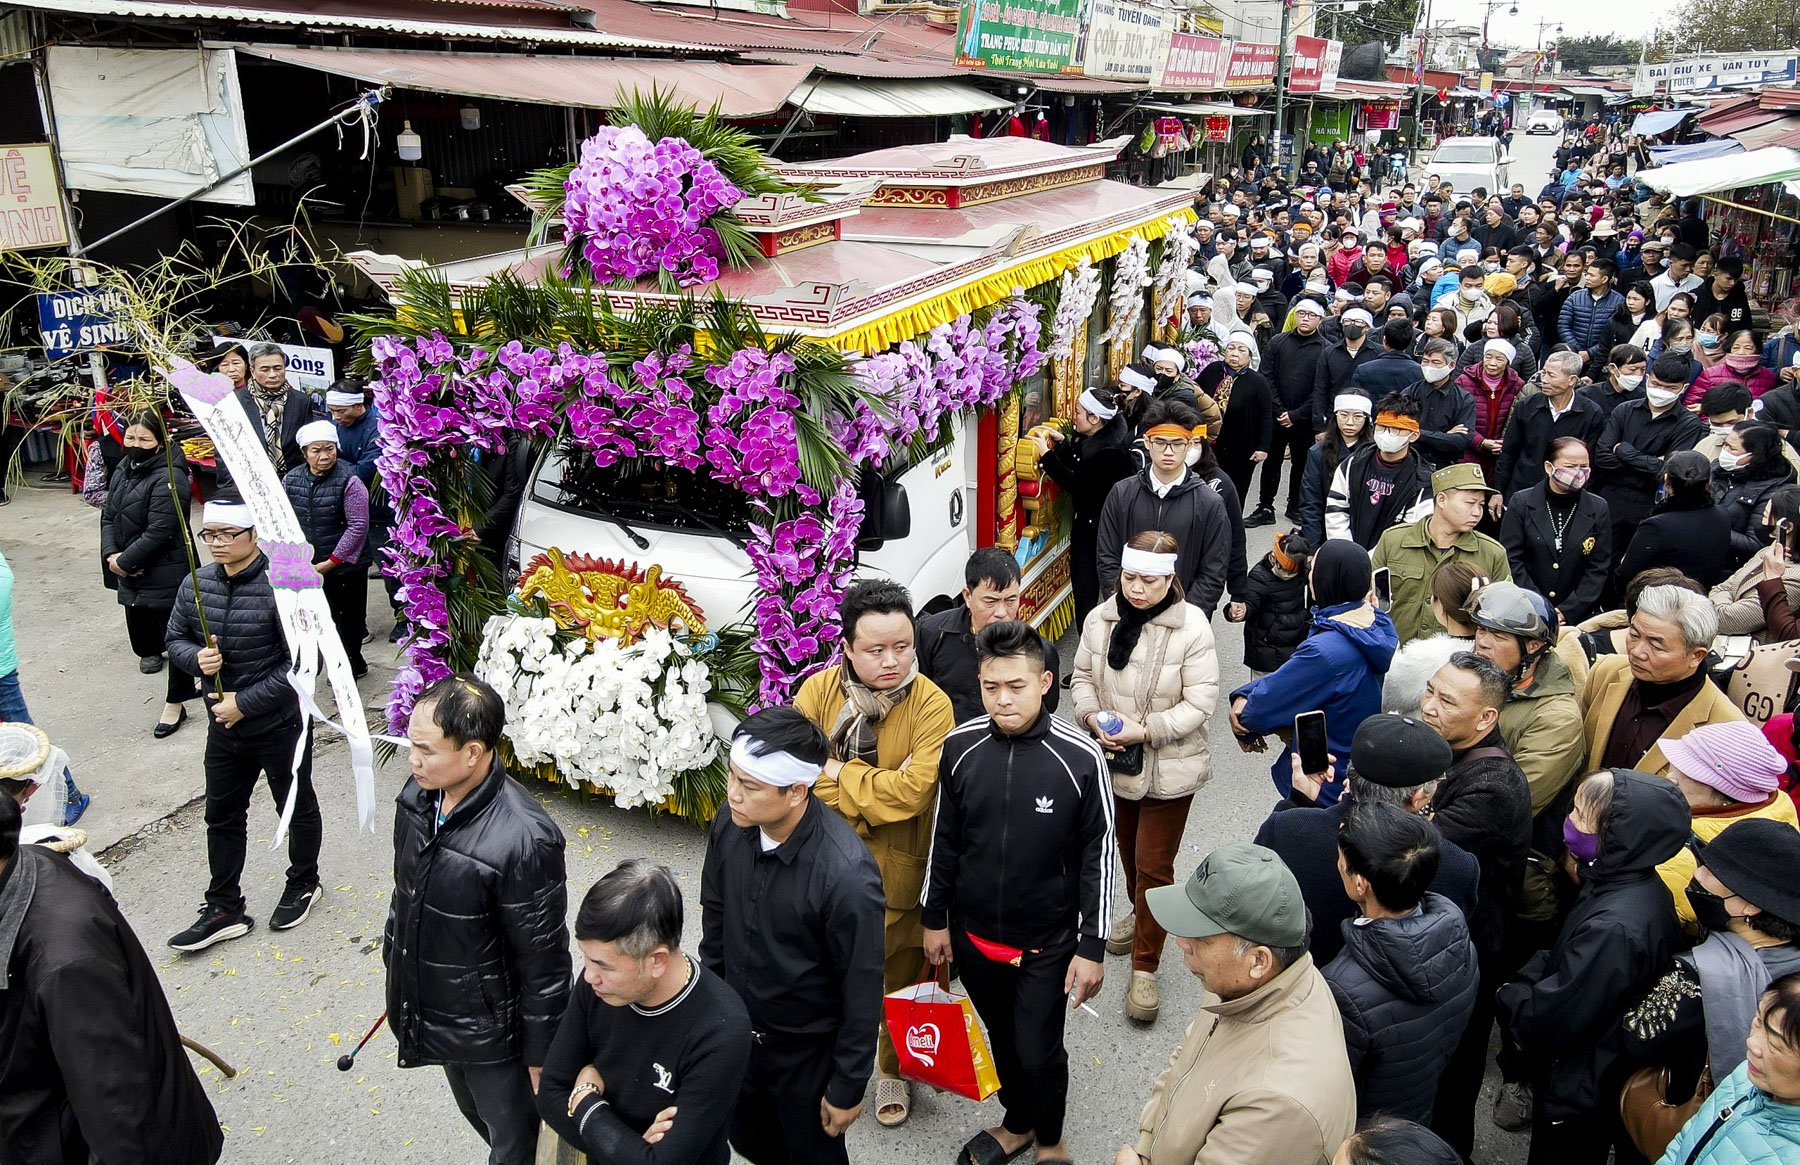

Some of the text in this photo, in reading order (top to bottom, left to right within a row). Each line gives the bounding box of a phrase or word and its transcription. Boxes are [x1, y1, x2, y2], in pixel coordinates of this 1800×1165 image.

[981, 33, 1003, 49] TRANG
[1698, 64, 1712, 72] XE
[53, 294, 97, 321] DỊCH
[42, 321, 129, 353] VỆ SINH
